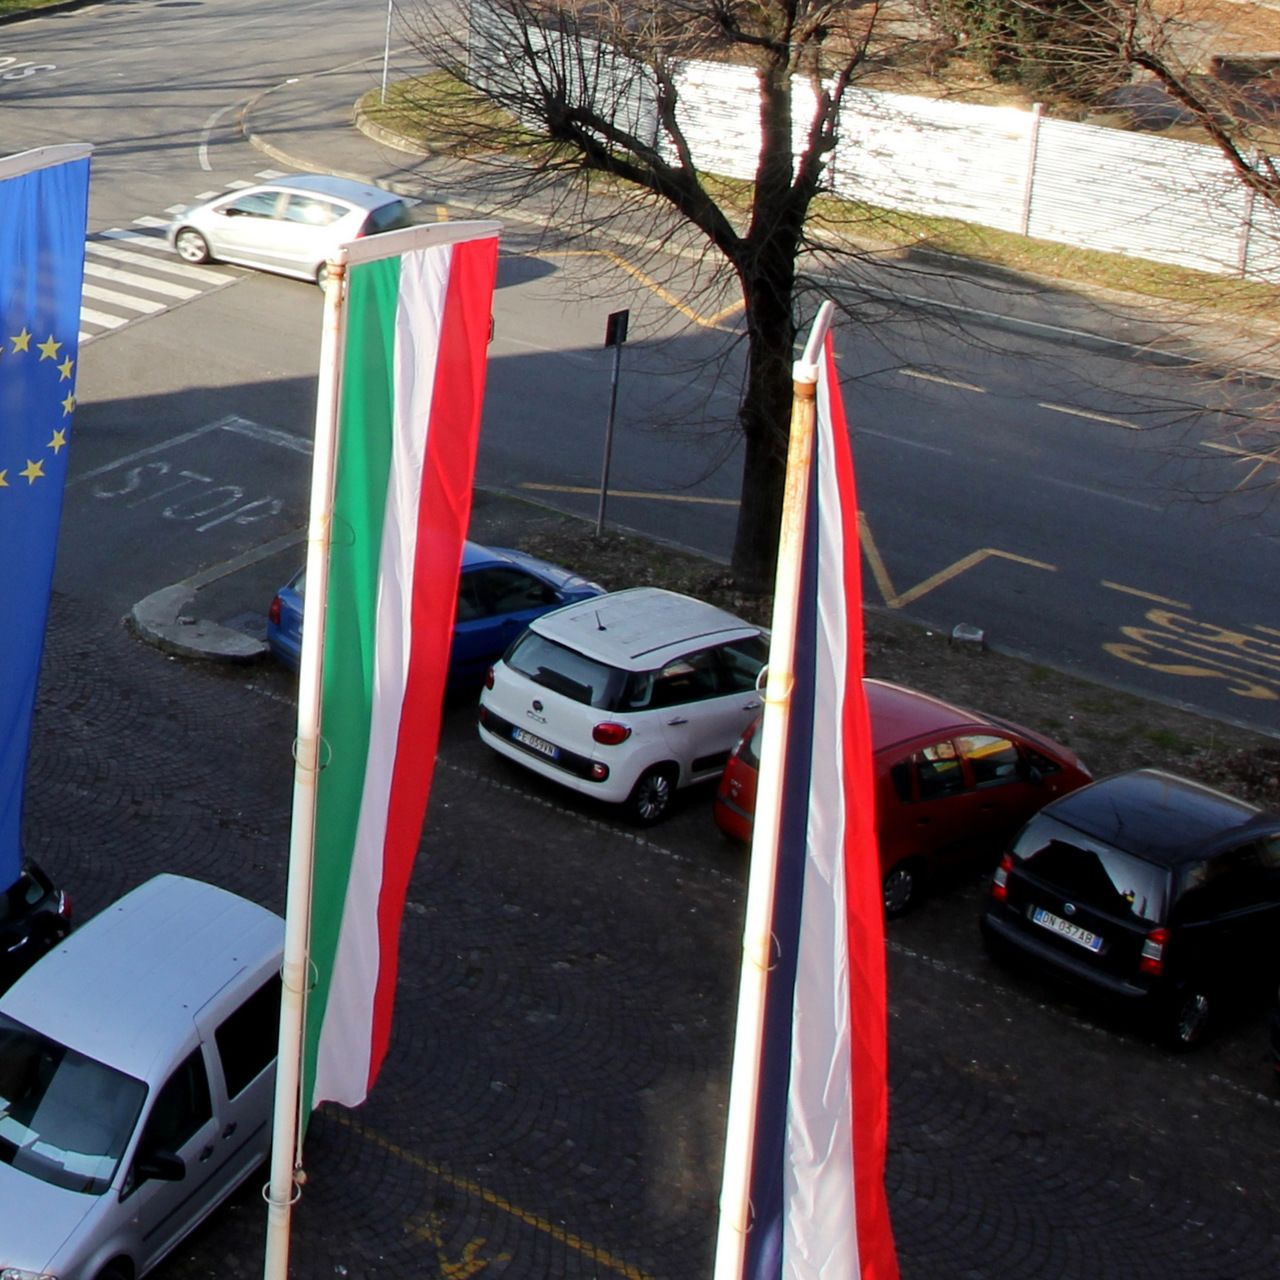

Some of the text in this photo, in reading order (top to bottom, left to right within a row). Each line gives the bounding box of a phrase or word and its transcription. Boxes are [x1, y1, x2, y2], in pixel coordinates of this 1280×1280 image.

[95, 462, 283, 532] STOP
[1101, 608, 1280, 700] BUS
[1042, 911, 1055, 926] DN
